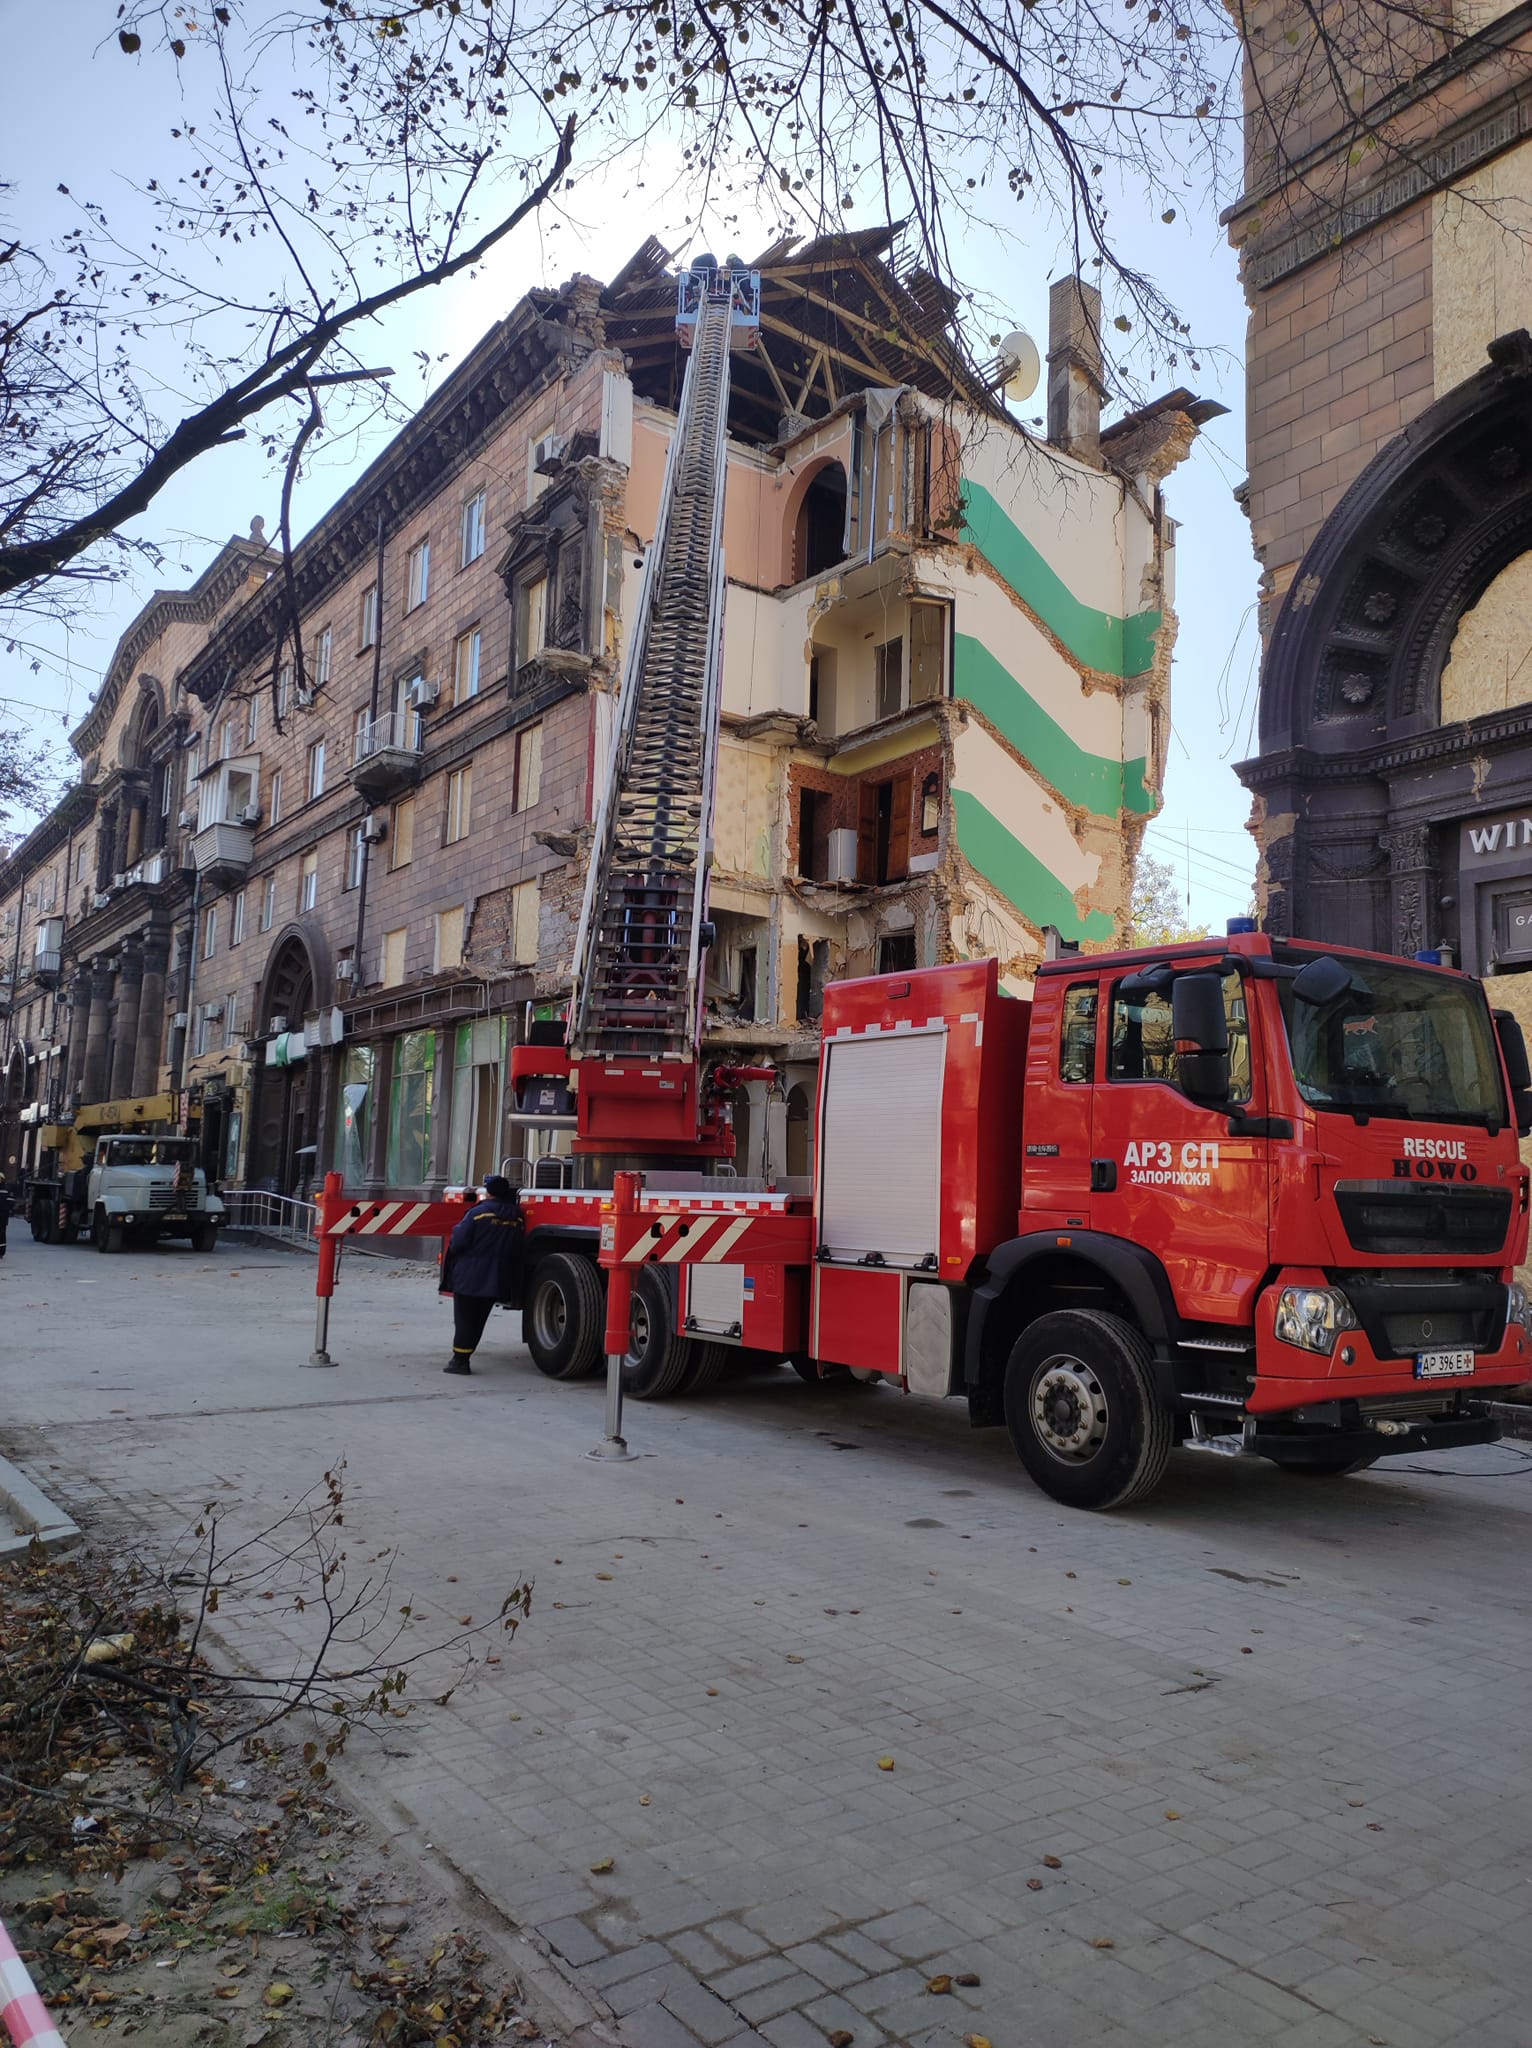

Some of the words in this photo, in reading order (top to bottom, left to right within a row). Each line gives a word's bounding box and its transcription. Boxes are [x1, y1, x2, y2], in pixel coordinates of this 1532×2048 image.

[1181, 1142, 1219, 1169] СП
[1403, 1137, 1467, 1160] RESCUE
[1130, 1169, 1210, 1186] ЗАПОРІЖЖЯ
[1391, 1159, 1477, 1181] HOWO
[1423, 1356, 1436, 1373] AP
[1439, 1354, 1454, 1371] 396
